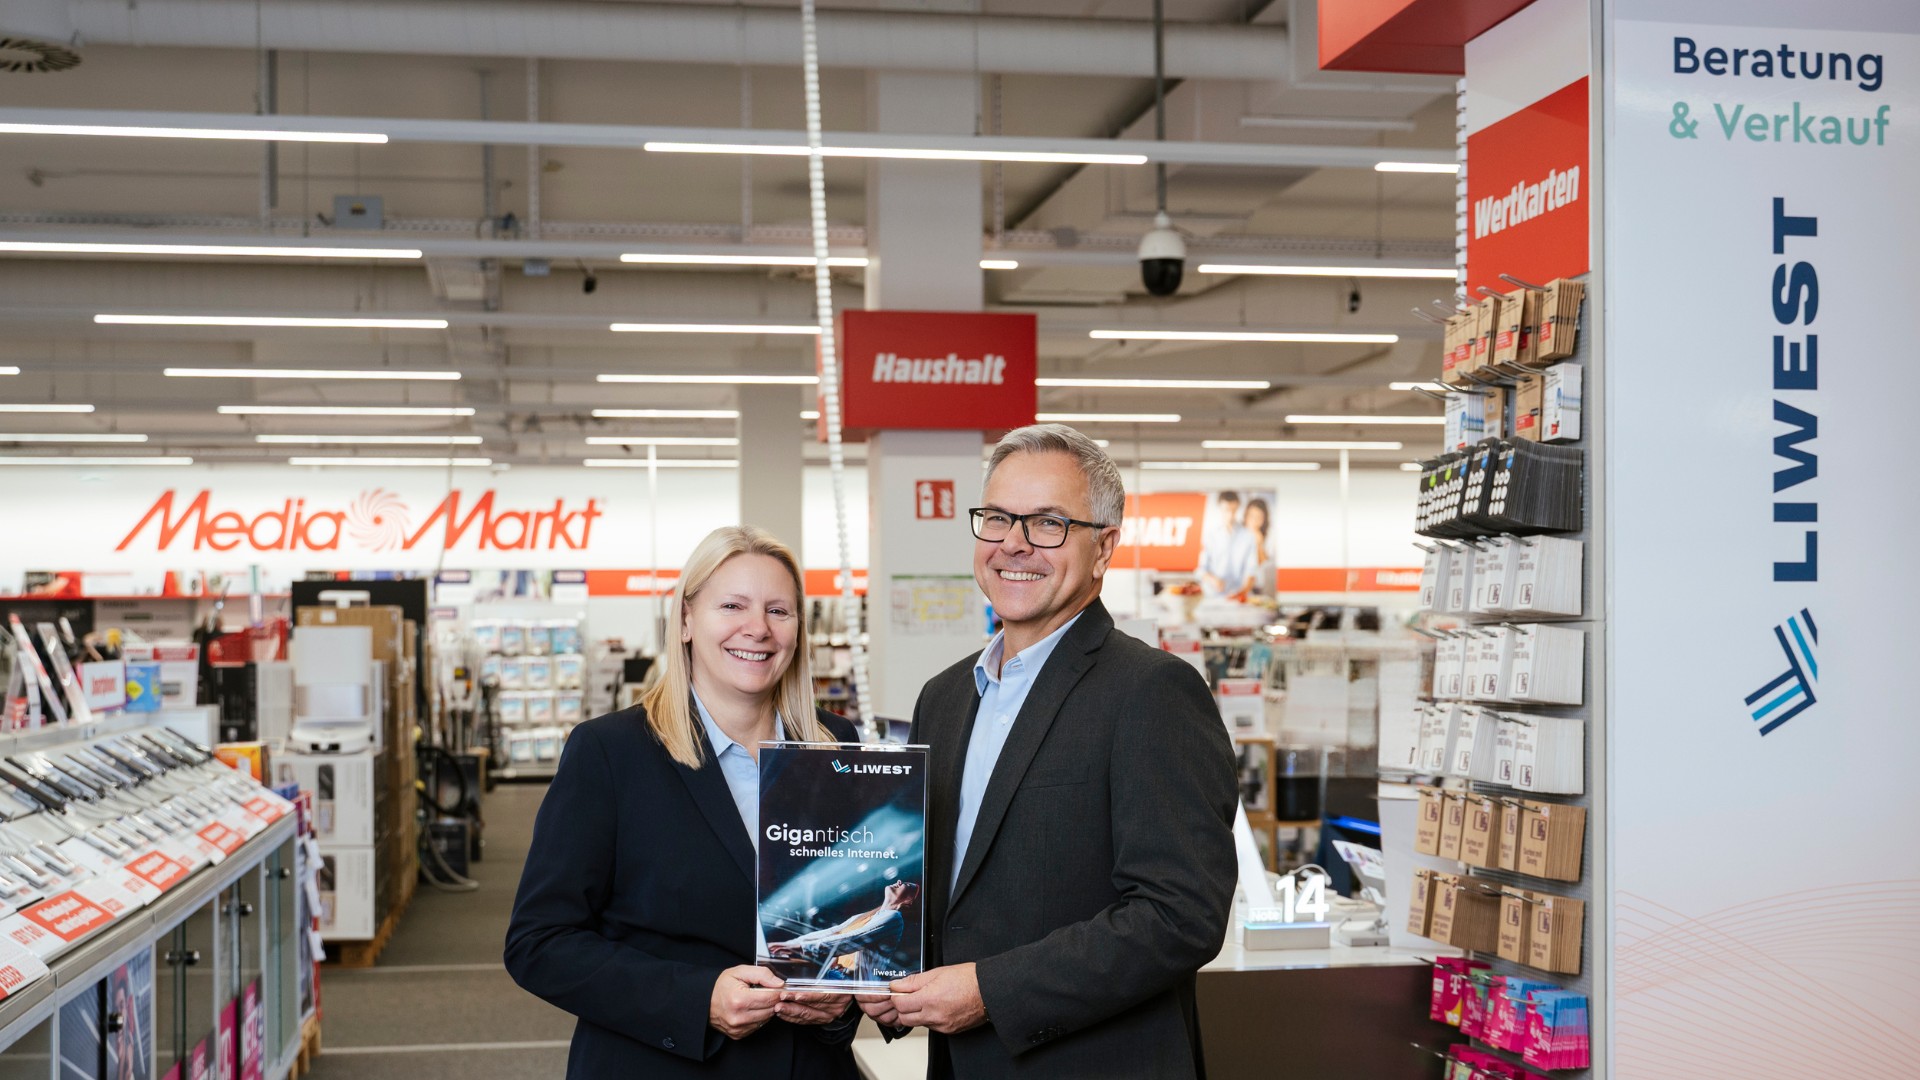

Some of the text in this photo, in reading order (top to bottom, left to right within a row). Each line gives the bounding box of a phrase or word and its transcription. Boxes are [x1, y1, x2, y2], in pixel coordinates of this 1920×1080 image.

[1673, 37, 1883, 92] Beratung
[1668, 101, 1891, 146] & Verkauf
[1474, 165, 1580, 240] Wertkarten
[872, 352, 1006, 385] Haushalt
[1771, 196, 1820, 582] LIWEST
[115, 489, 604, 551] Media Markt
[853, 764, 912, 775] LIWEST
[766, 823, 874, 846] Gigantisch
[789, 846, 899, 859] schnelles Internet.
[1276, 874, 1330, 922] 14
[873, 968, 906, 976] liwest.at
